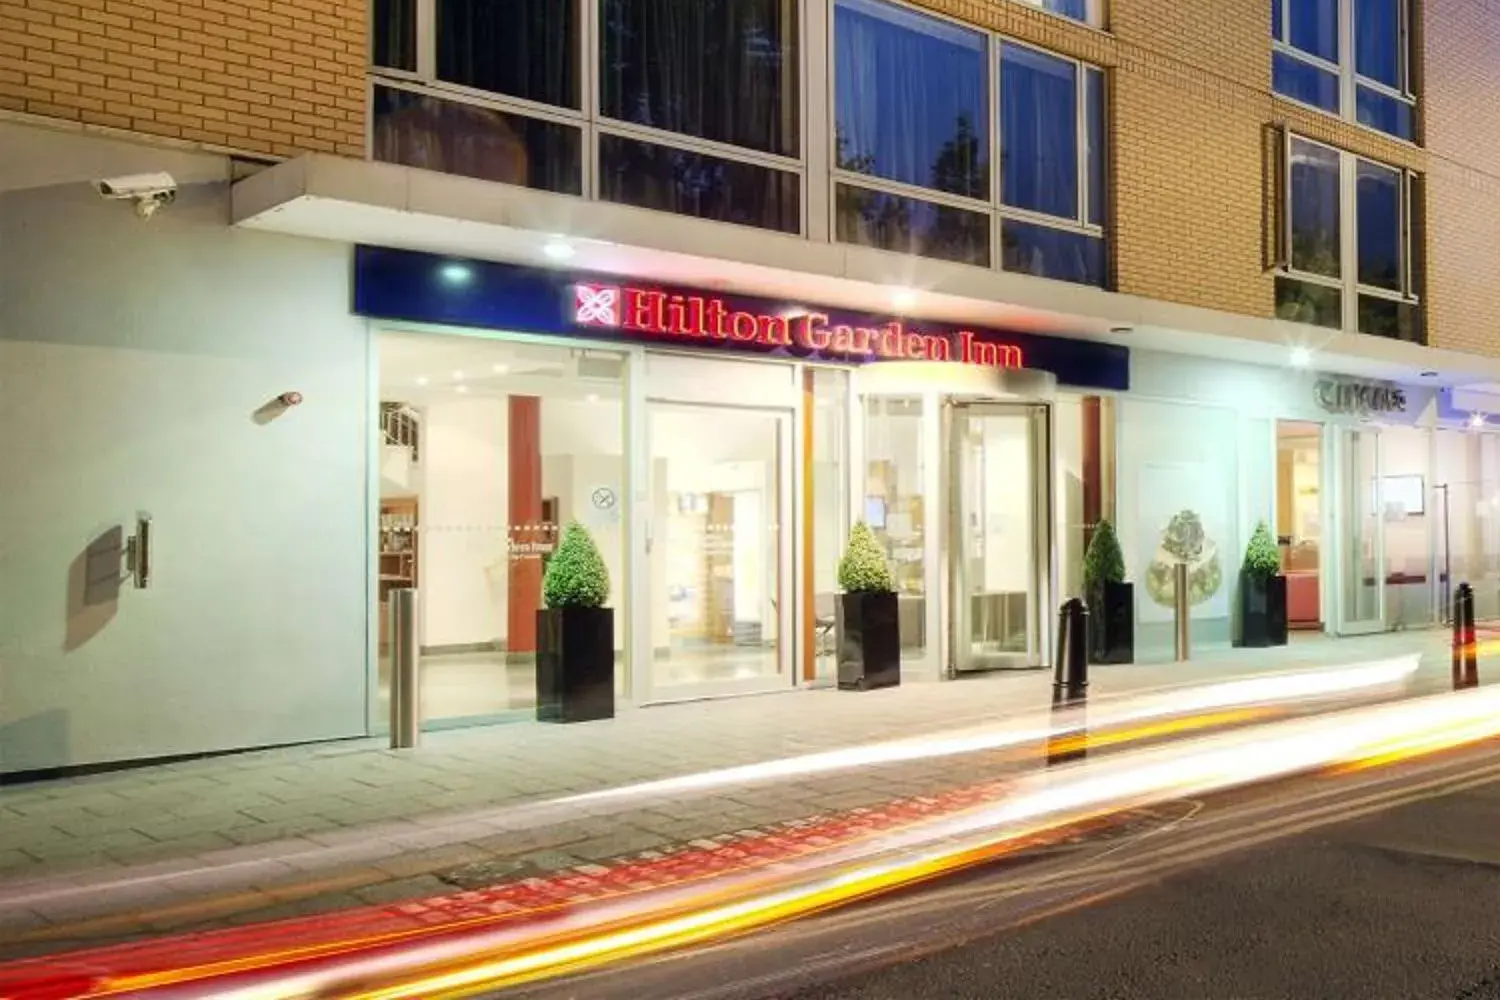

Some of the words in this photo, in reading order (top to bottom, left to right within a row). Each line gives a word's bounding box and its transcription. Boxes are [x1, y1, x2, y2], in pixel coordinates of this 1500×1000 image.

[624, 286, 794, 346] Hilton
[800, 312, 950, 361] Garden
[959, 330, 1023, 369] Inn
